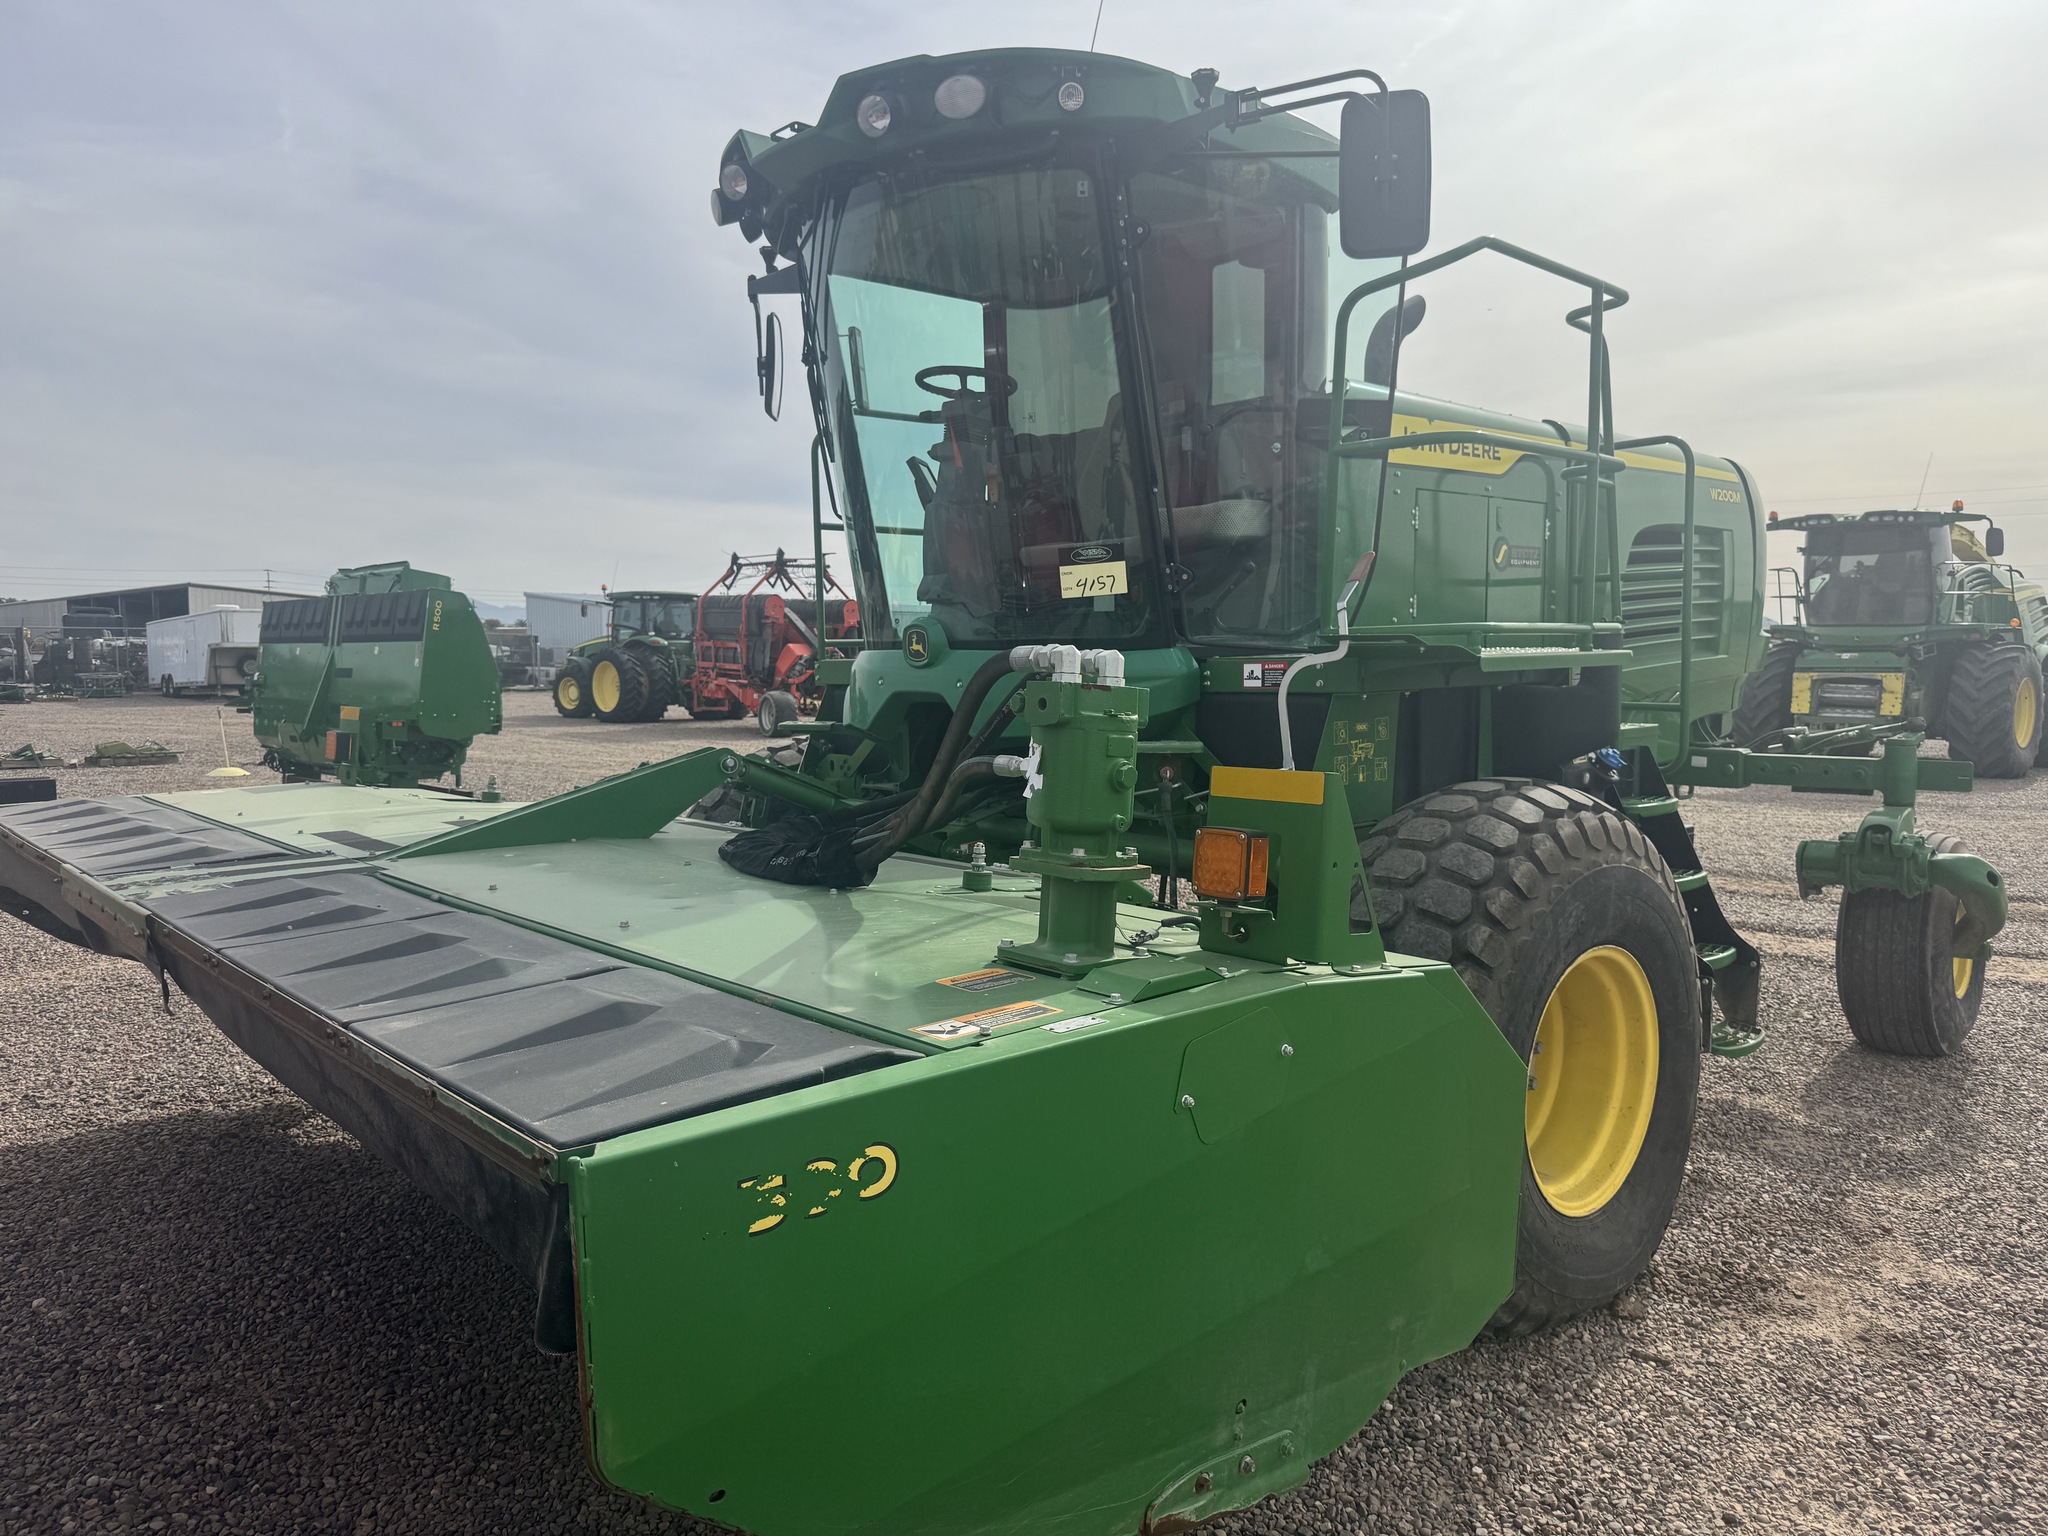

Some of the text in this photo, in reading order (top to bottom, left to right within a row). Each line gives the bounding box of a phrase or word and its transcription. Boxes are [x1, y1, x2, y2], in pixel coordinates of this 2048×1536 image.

[1448, 442, 1502, 461] DEERE
[1709, 487, 1741, 504] W200M
[1076, 575, 1115, 597] 4157
